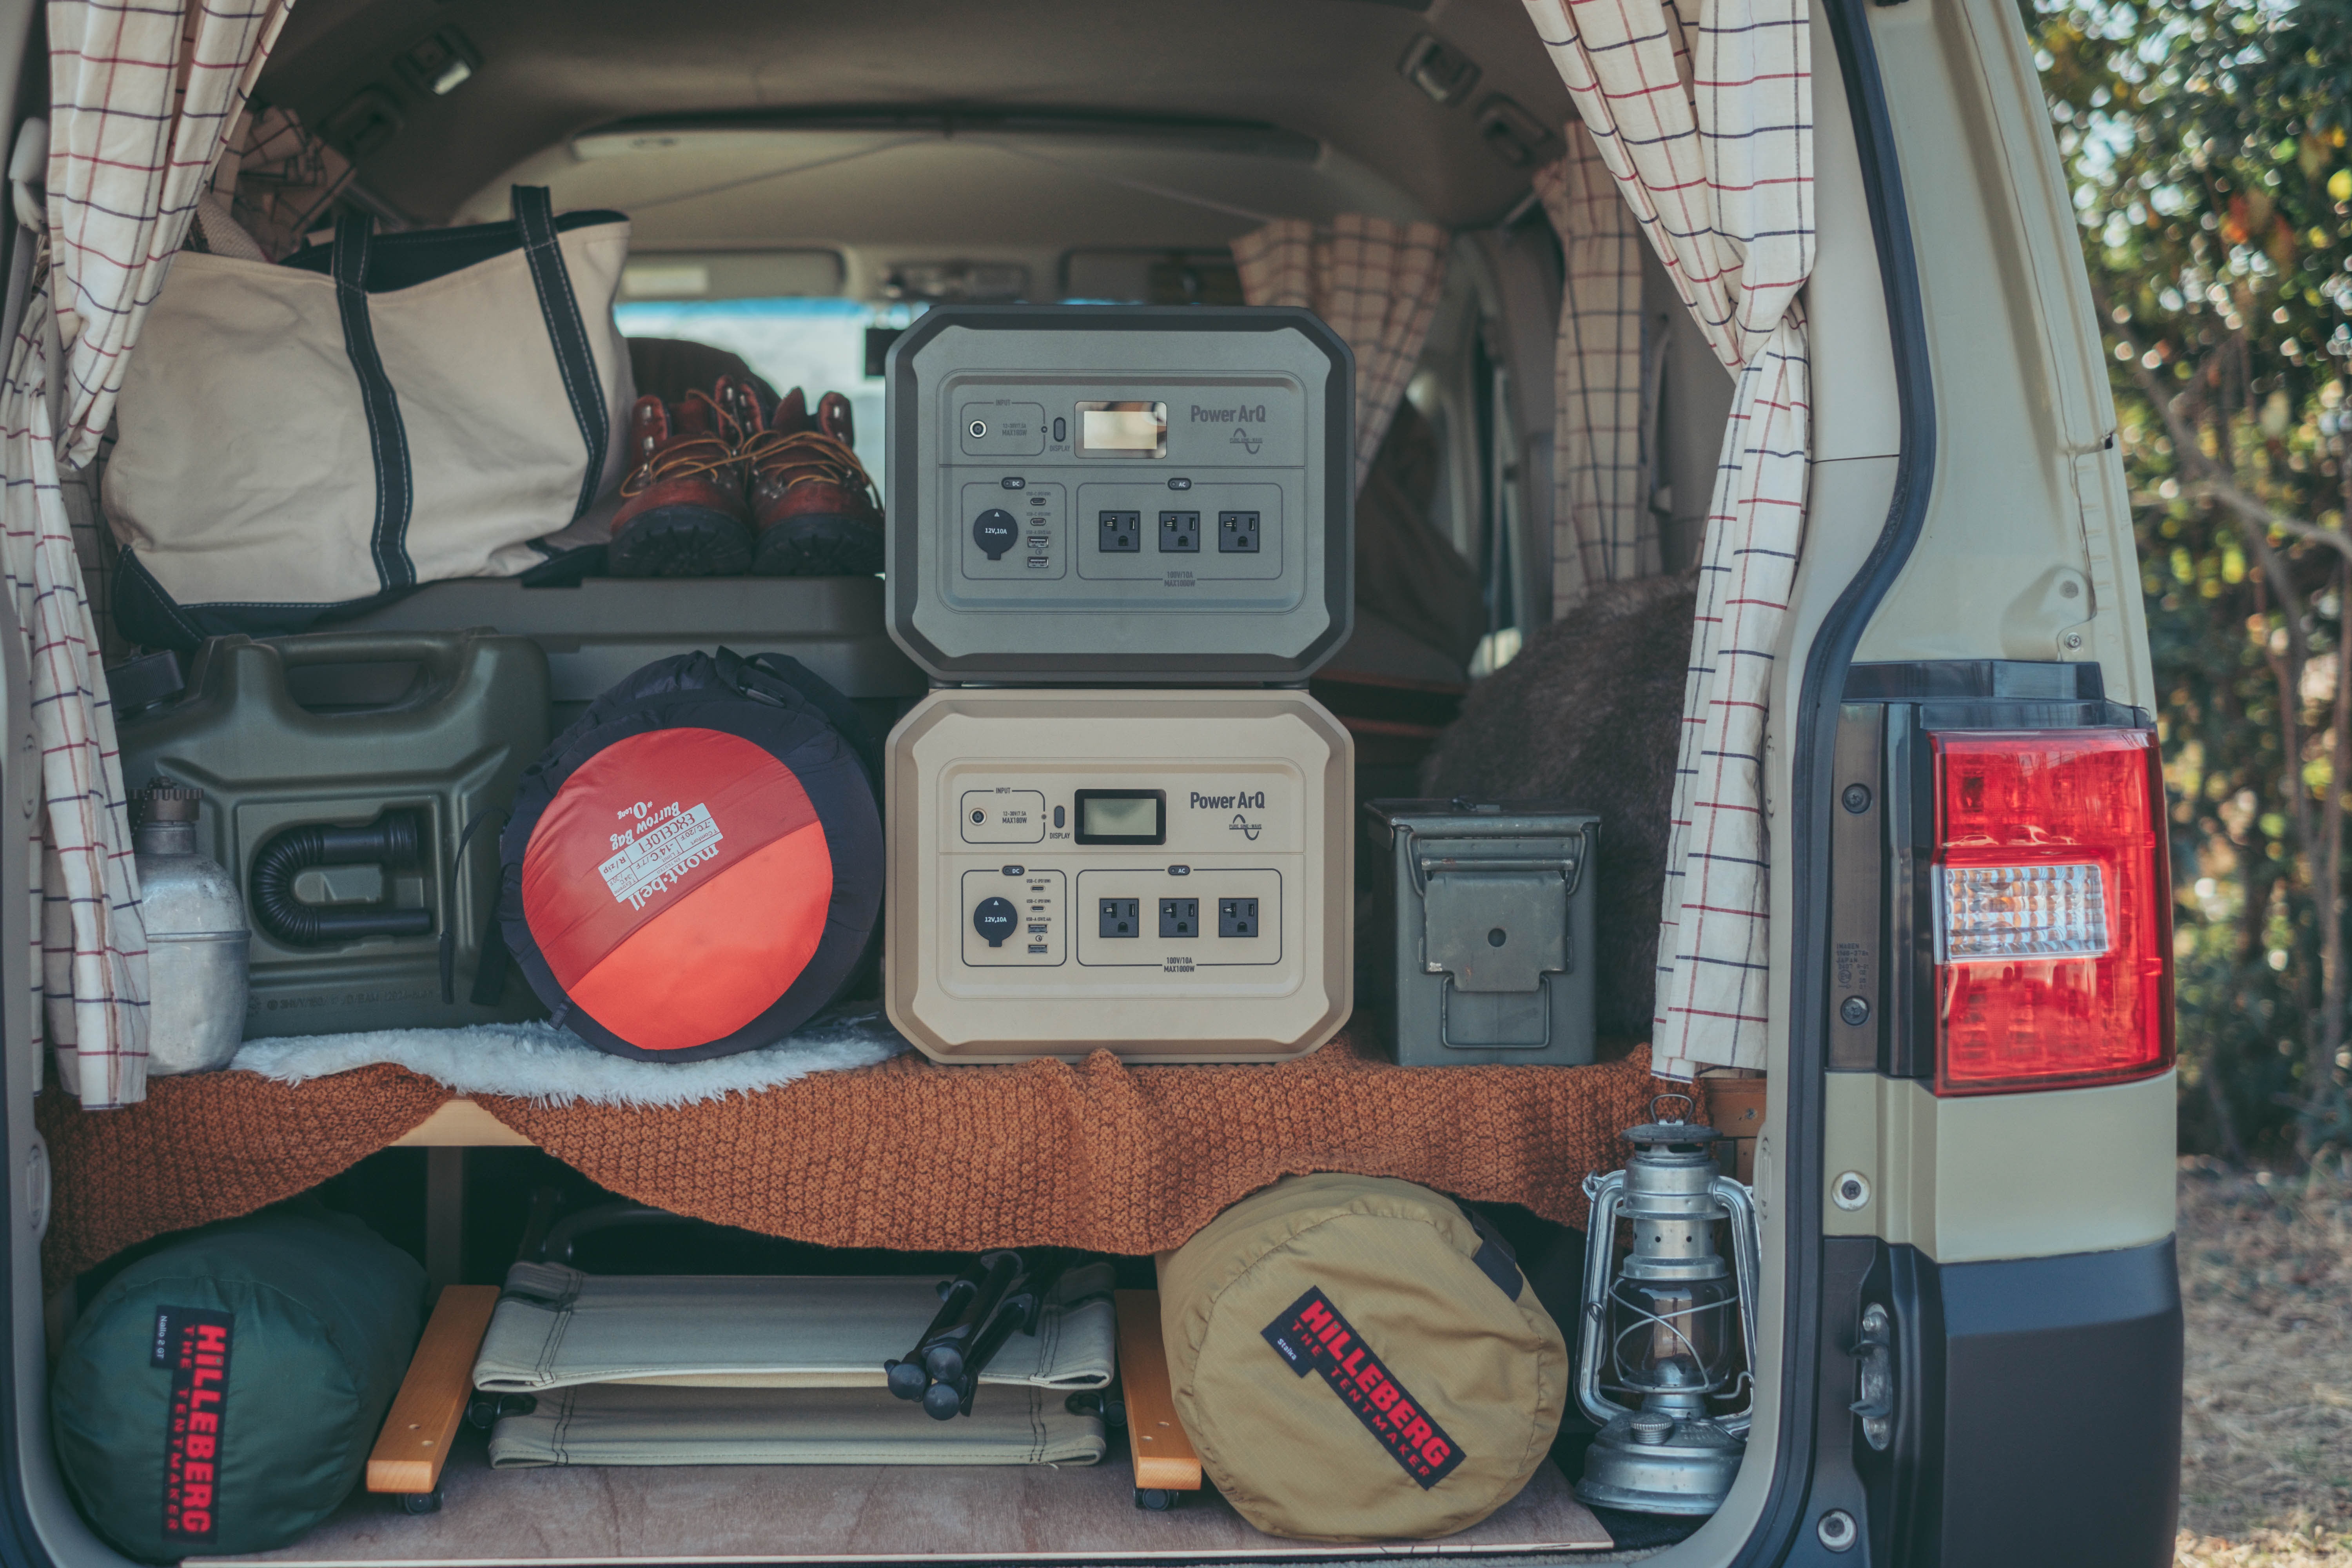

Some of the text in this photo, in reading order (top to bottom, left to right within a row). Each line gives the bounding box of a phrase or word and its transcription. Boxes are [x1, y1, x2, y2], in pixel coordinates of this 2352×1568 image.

[1191, 405, 1266, 422] Power ArQ
[1191, 791, 1265, 809] Power ArQ
[617, 807, 633, 820] Long
[610, 802, 681, 851] Burrow Bag
[638, 813, 695, 854] EXCELOFT
[690, 831, 713, 846] Comfort
[604, 857, 626, 873] R/zip
[662, 852, 676, 862] Limit
[613, 880, 632, 895] Extreme
[158, 1316, 168, 1337] Nallo
[156, 1347, 165, 1359] GT
[1277, 1338, 1297, 1360] Staika
[1300, 1300, 1450, 1467] HILLEBERG
[1292, 1320, 1430, 1476] THE TENTMAKER
[167, 1325, 195, 1530] THE TENTMAKER
[182, 1324, 227, 1532] HILLEBERG
